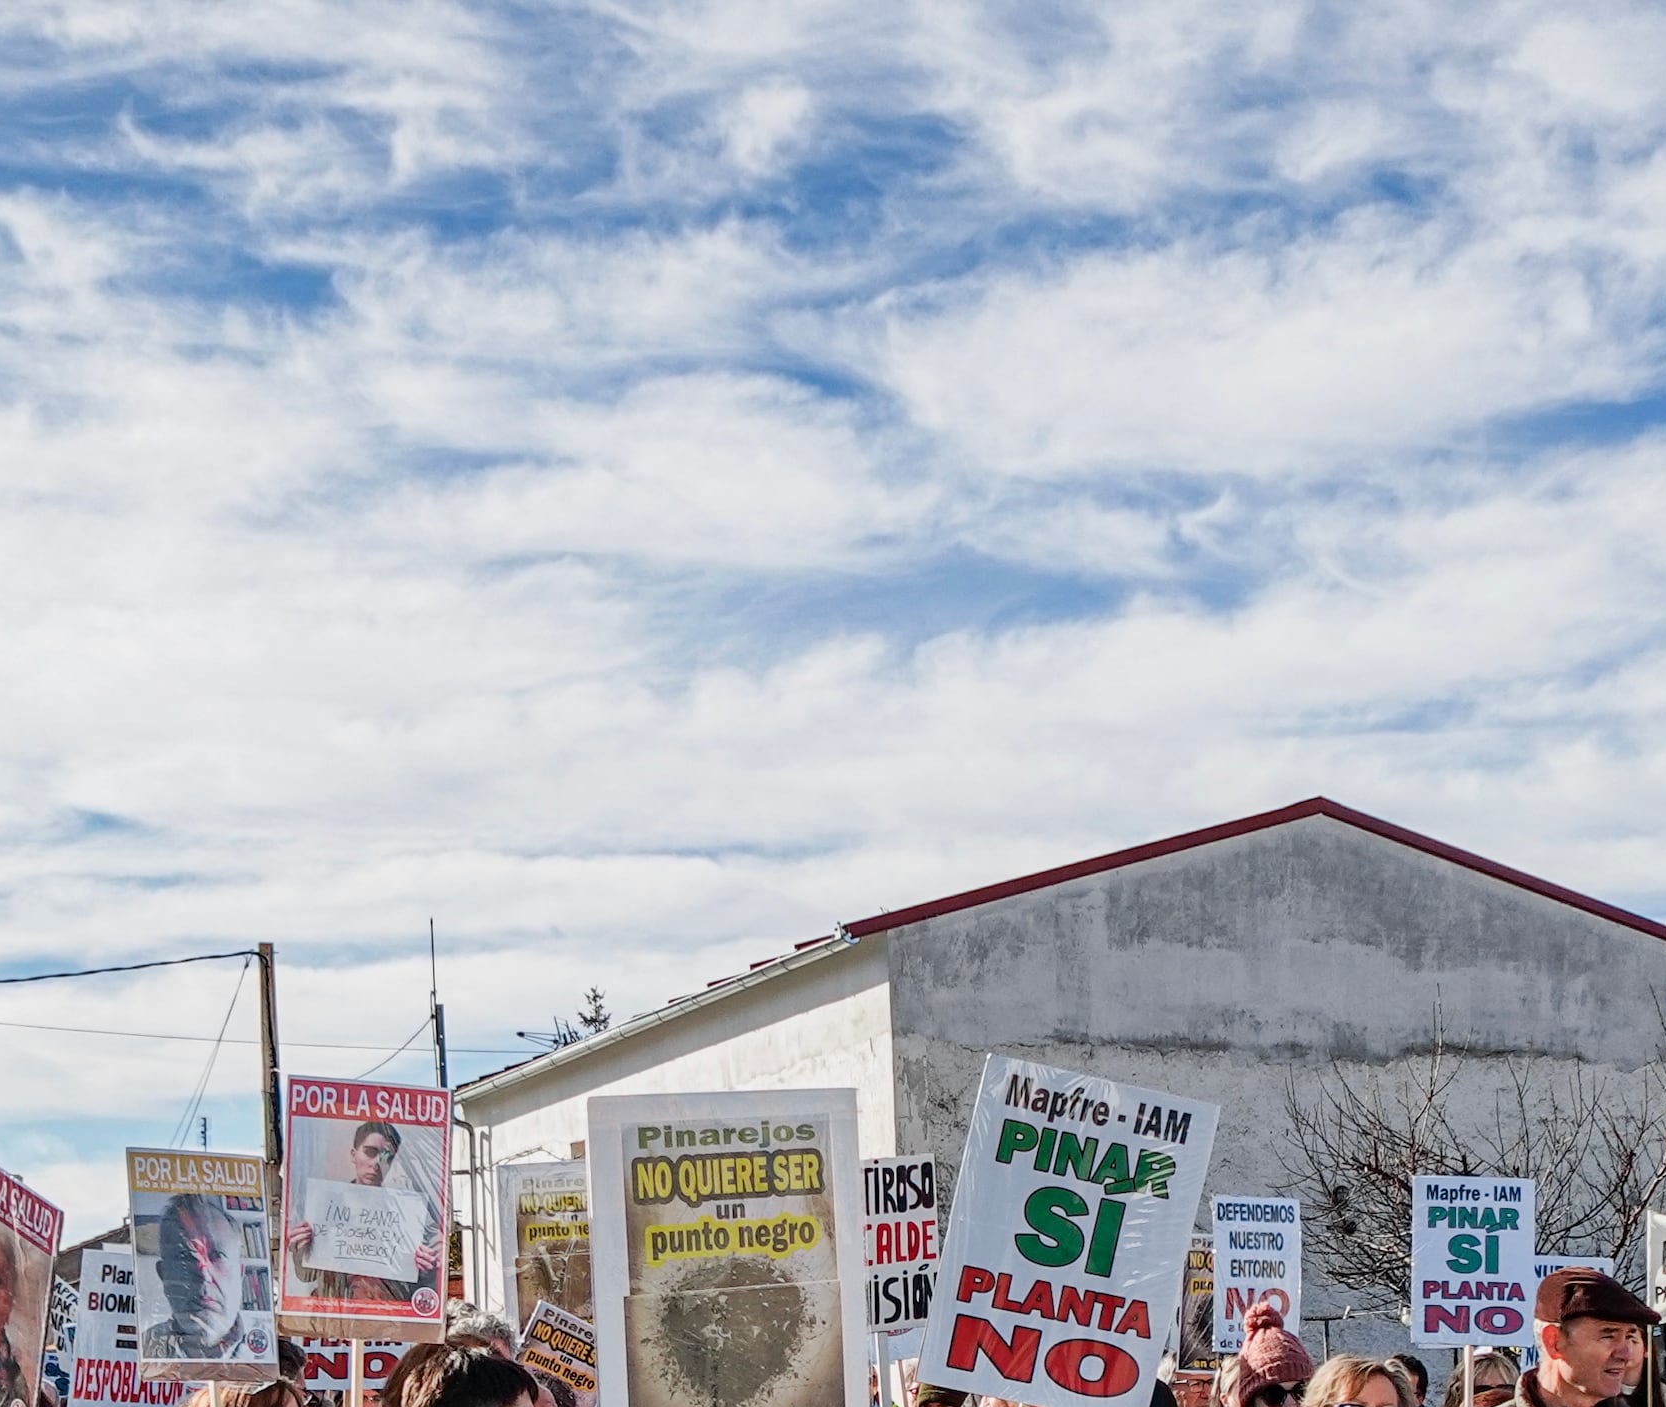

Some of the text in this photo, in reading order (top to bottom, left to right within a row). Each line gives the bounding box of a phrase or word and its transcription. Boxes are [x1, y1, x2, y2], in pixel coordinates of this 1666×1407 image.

[292, 1084, 446, 1122] POR LA SALUD
[1005, 1074, 1110, 1127] Mapfre
[1133, 1103, 1193, 1145] IAM
[637, 1121, 815, 1149] Pinarejos
[133, 1157, 258, 1186] POR LA SALUD
[995, 1119, 1176, 1199] PINAR
[522, 1177, 584, 1190] Pinare
[636, 1153, 821, 1202] NO QUIERE SER
[1426, 1184, 1481, 1203] Mapfre
[1493, 1186, 1521, 1202] IAM
[9, 1187, 53, 1239] SALUD
[359, 1208, 400, 1227] PLANTA
[716, 1201, 746, 1219] un
[1217, 1202, 1295, 1224] DEFENDEMOS
[1427, 1206, 1520, 1230] PINAR
[313, 1223, 328, 1237] DE
[528, 1224, 571, 1241] punto
[651, 1218, 816, 1260] punto negro
[865, 1220, 937, 1267] ALDE
[1229, 1231, 1284, 1251] NUESTRO
[1188, 1251, 1203, 1270] NO
[1230, 1259, 1286, 1280] ENTORNO
[867, 1263, 937, 1326] ISIÓN
[956, 1265, 1151, 1339] PLANTA
[1224, 1287, 1291, 1321] NO
[1423, 1280, 1526, 1301] PLANTA
[1424, 1304, 1524, 1335] NO
[534, 1321, 552, 1341] NO
[551, 1328, 590, 1362] QUIERE
[946, 1313, 1140, 1398] NO
[1220, 1339, 1233, 1349] de
[304, 1351, 401, 1380] NO
[526, 1350, 595, 1391] punto negro
[560, 1354, 573, 1366] un
